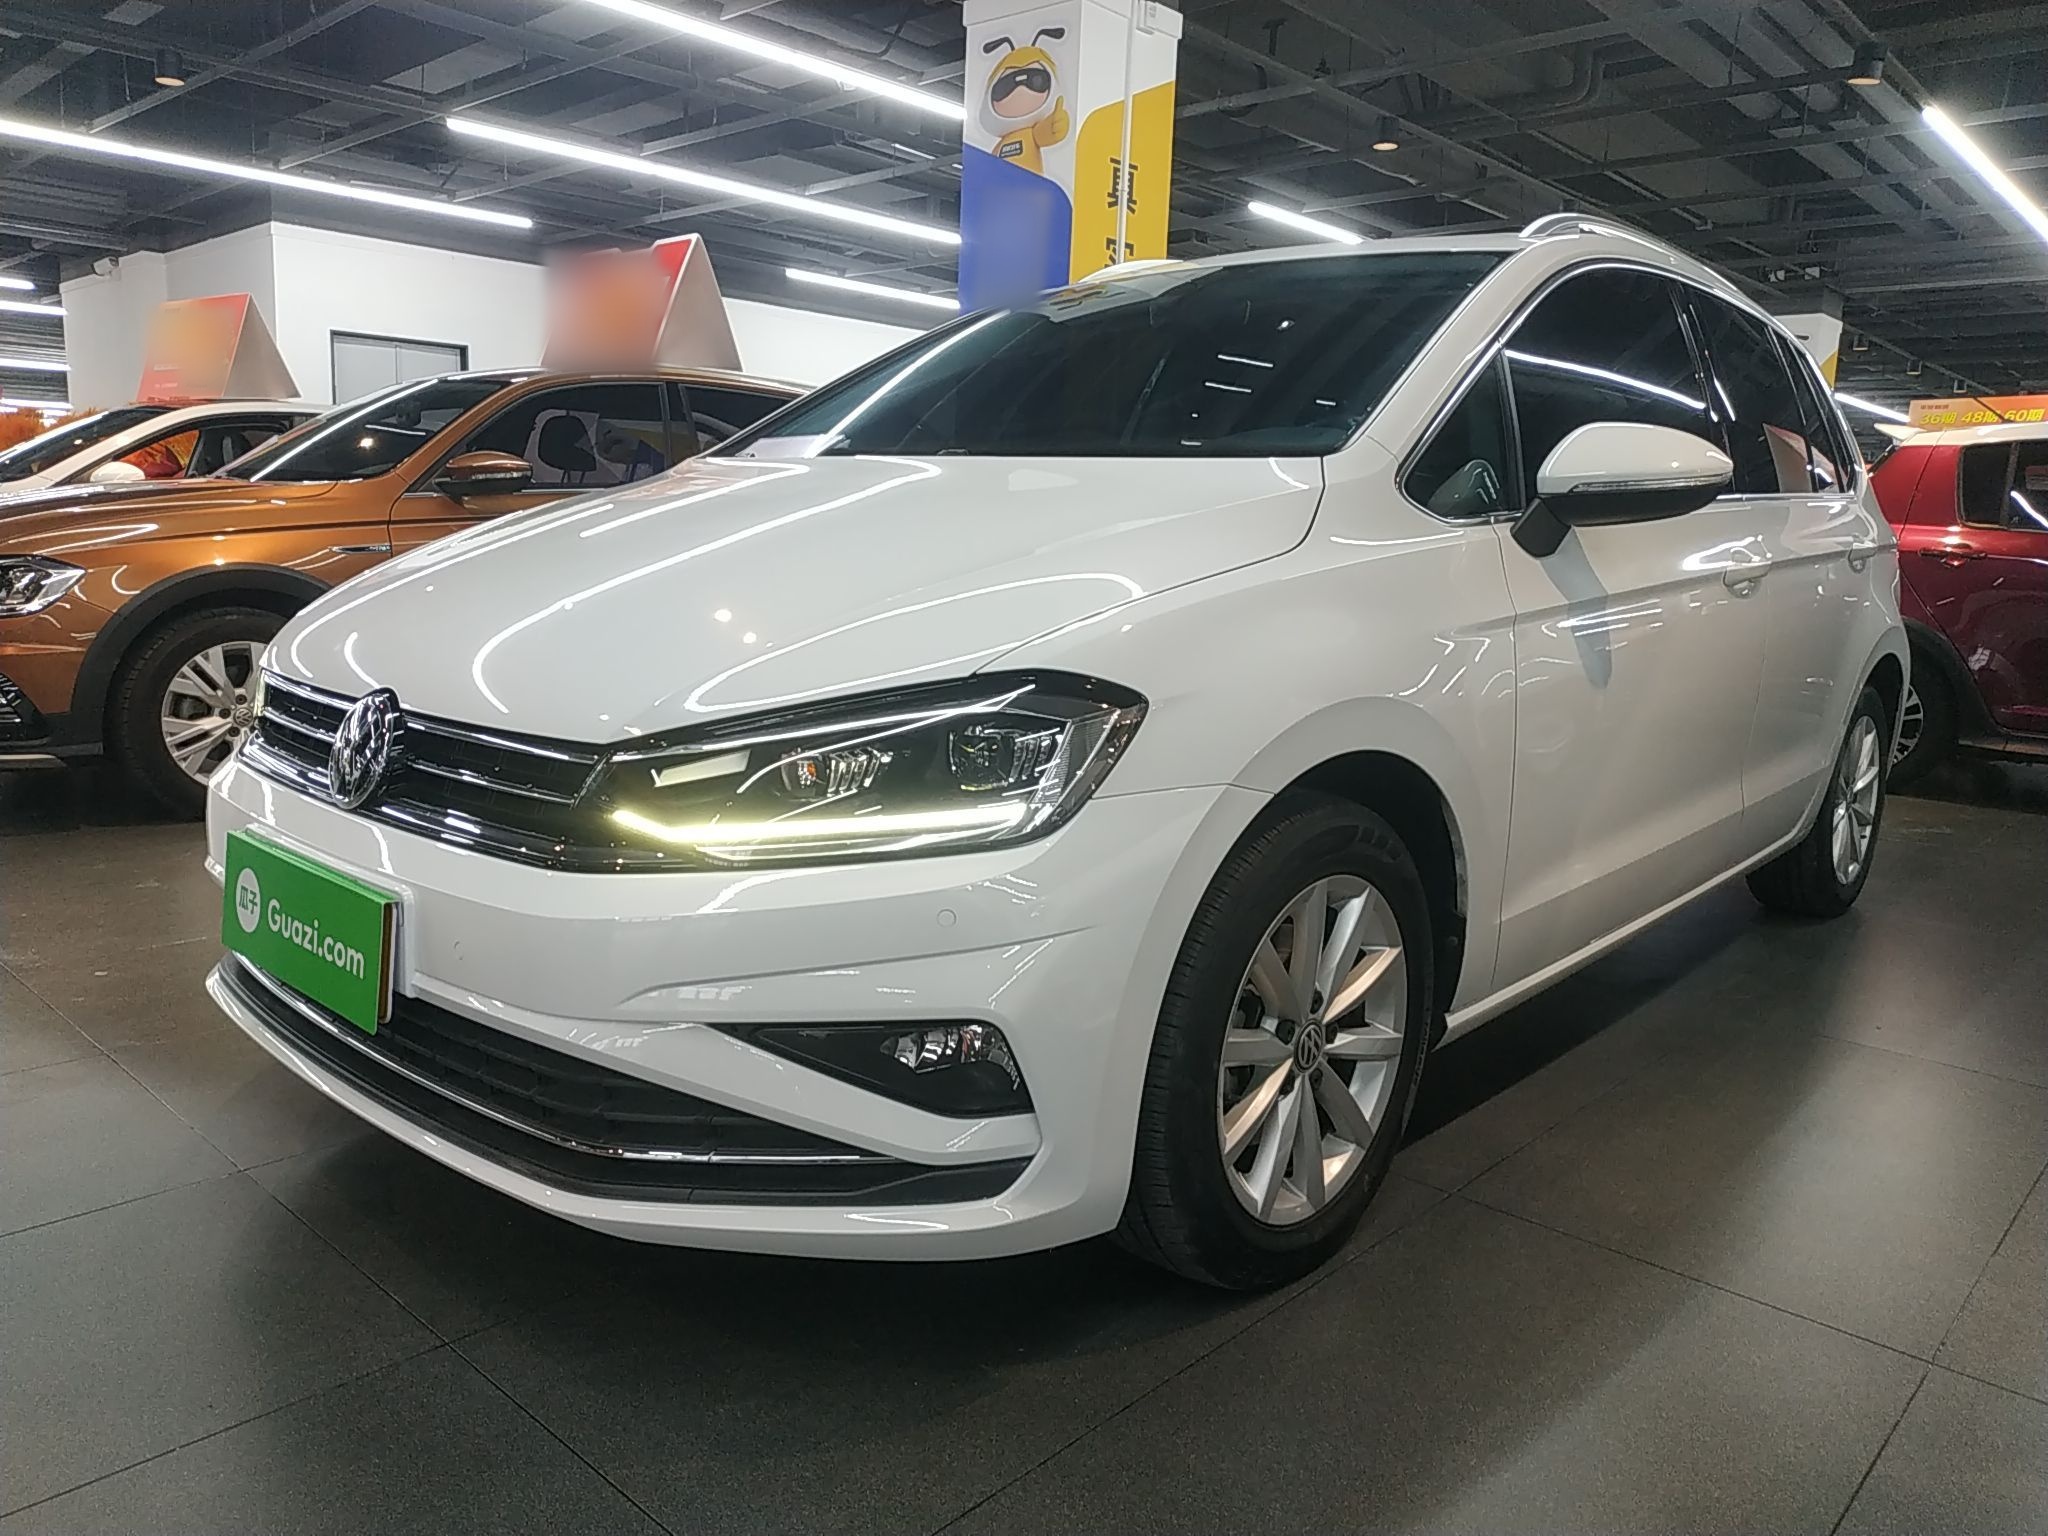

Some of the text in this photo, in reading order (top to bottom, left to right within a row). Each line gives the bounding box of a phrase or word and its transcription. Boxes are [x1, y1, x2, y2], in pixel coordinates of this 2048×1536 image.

[1921, 409, 2045, 424] 36期 48期 60期
[239, 885, 258, 915] 瓜子
[268, 898, 364, 979] Guazi.com
